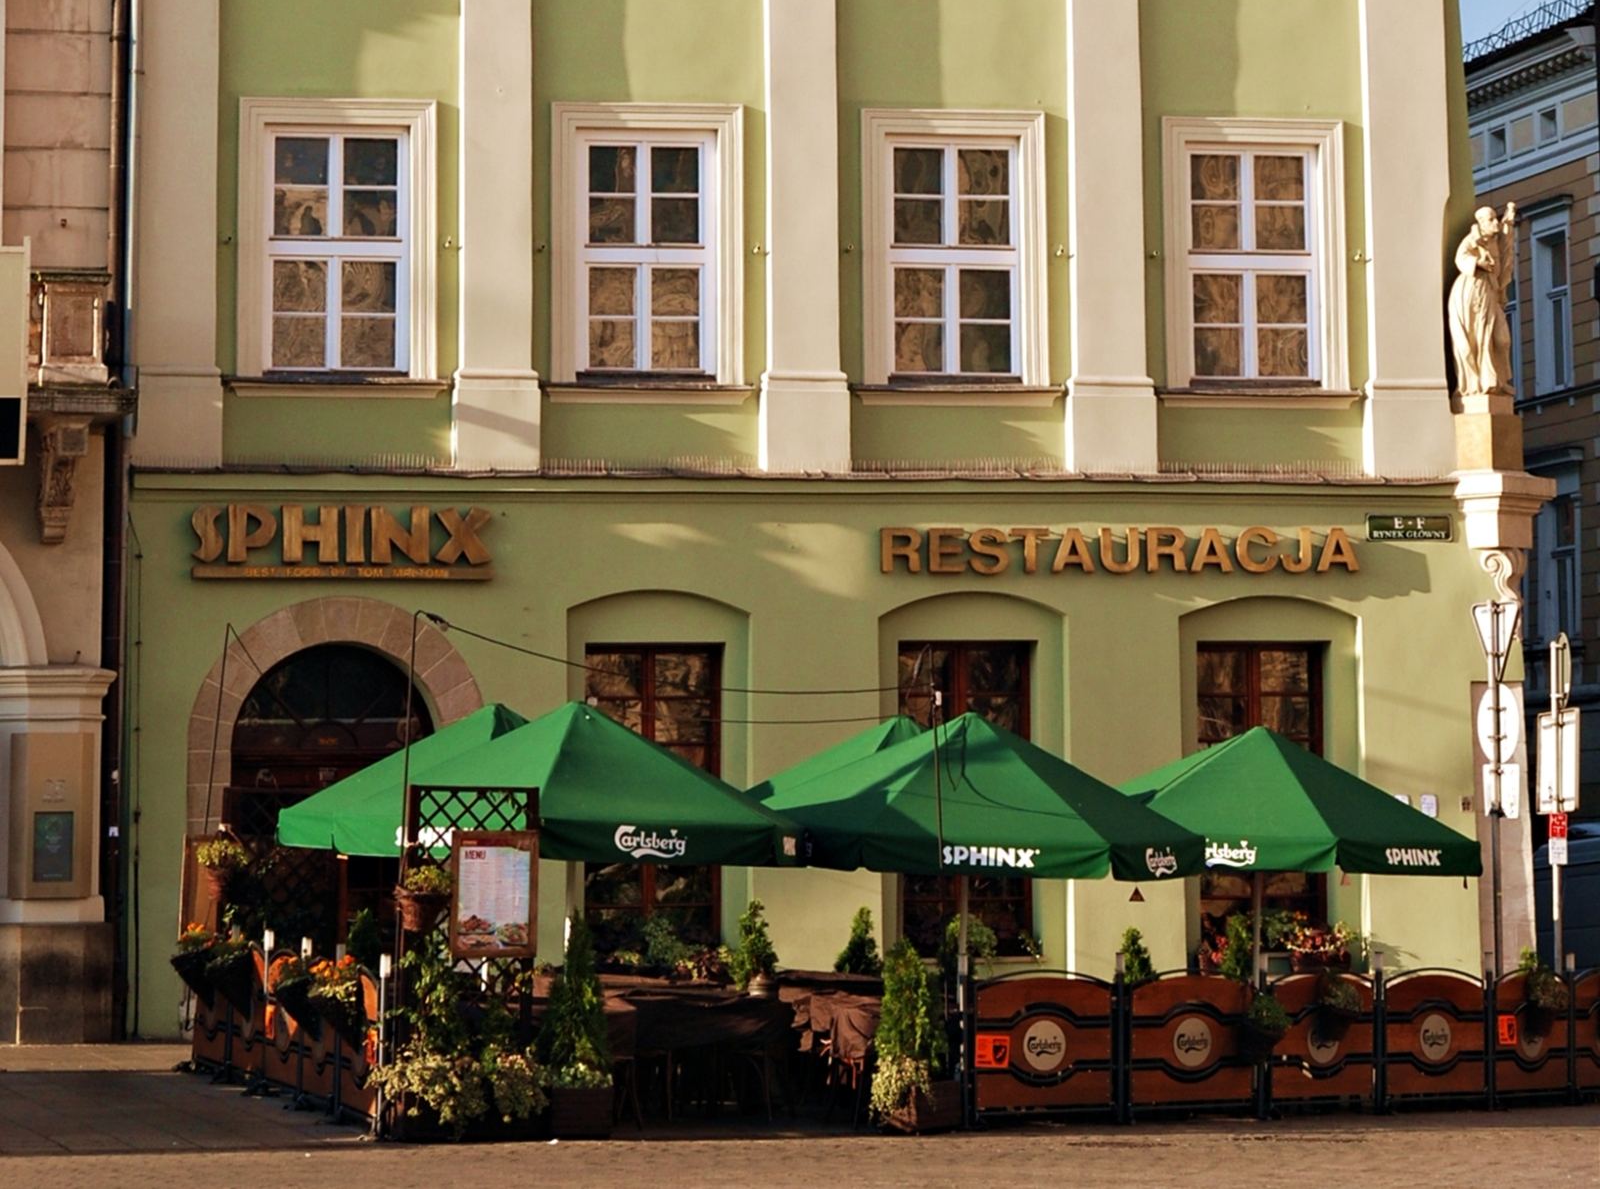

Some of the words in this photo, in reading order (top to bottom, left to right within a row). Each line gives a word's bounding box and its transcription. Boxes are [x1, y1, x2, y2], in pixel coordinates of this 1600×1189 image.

[191, 504, 492, 565] SPHINX
[879, 526, 1360, 574] RESTAURACJA
[357, 567, 384, 578] TOM
[464, 850, 487, 860] MENU
[614, 825, 688, 859] Carlsberg
[1204, 838, 1257, 867] rlsberg
[942, 845, 1035, 868] SPHINX
[1385, 848, 1441, 866] SPHINX
